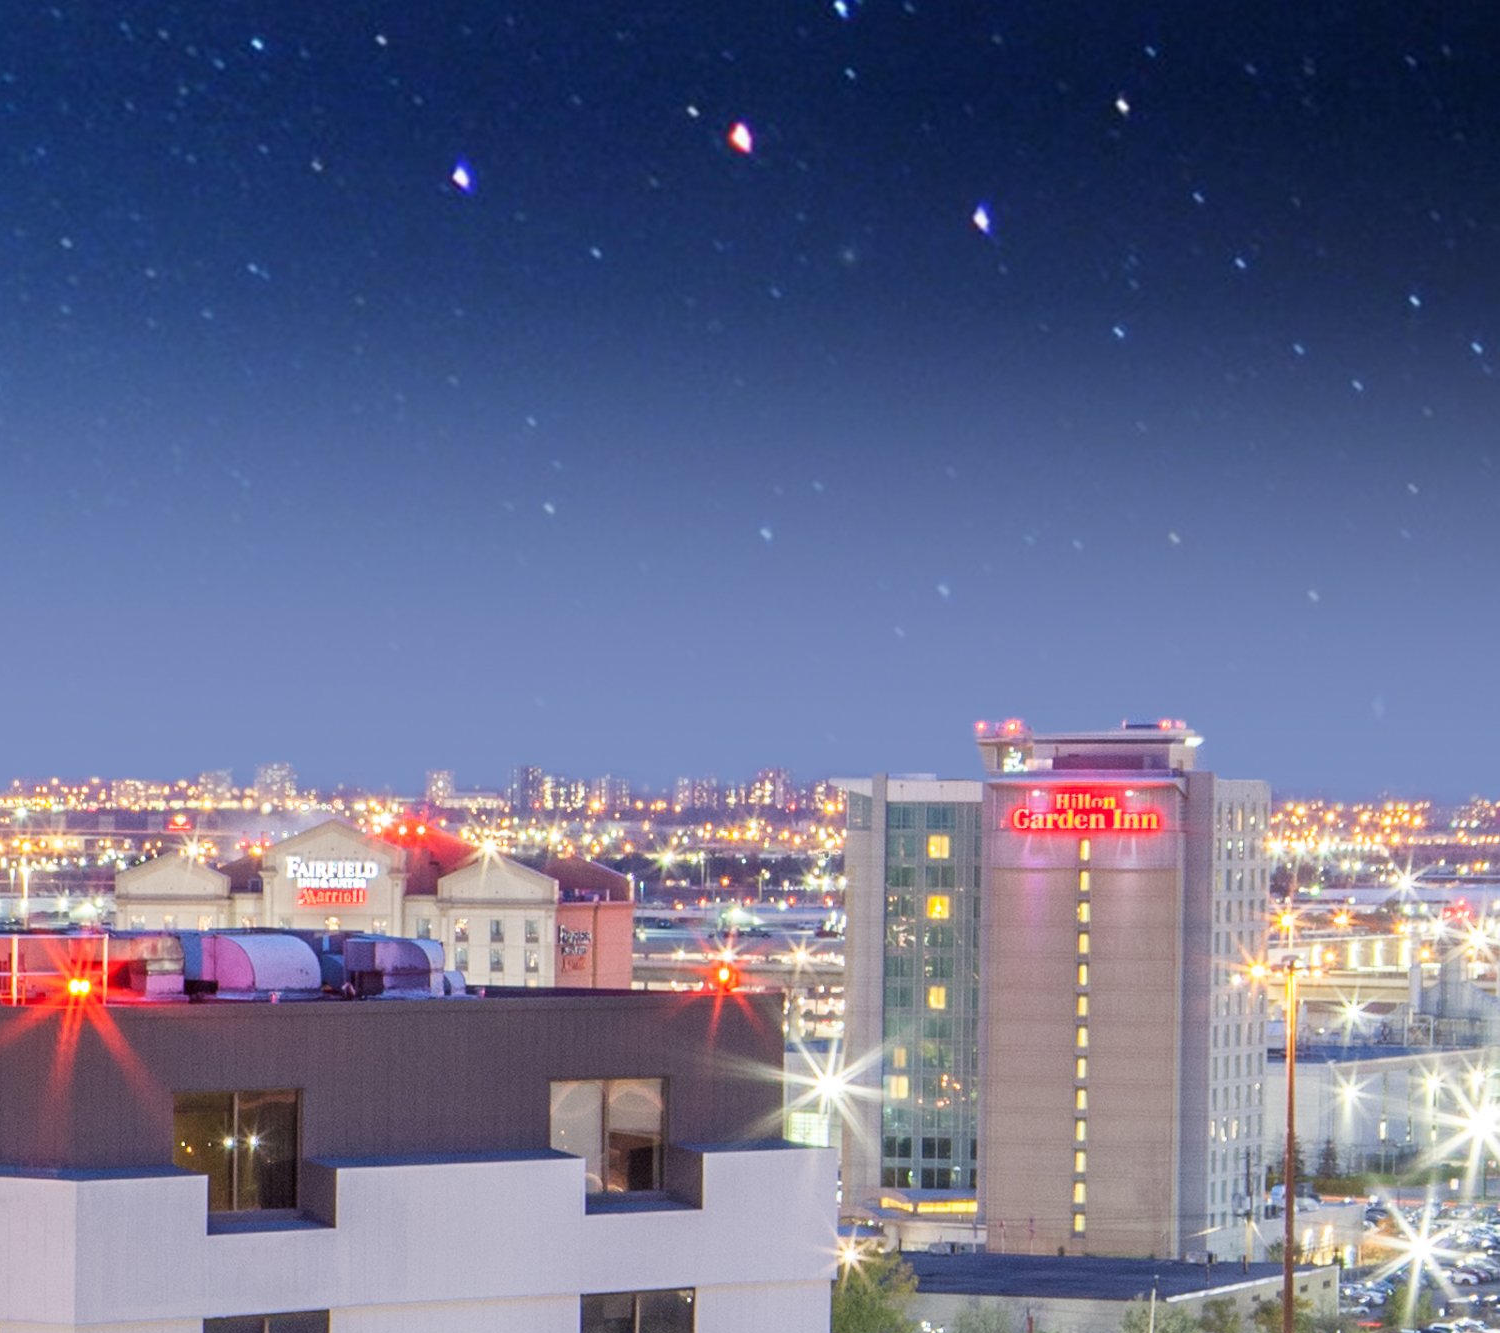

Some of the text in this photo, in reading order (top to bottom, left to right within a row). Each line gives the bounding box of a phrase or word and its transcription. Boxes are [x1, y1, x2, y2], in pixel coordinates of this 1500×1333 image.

[1055, 793, 1116, 810] Hilton
[1012, 809, 1159, 830] Garden Inn
[285, 856, 379, 878] FAIRFIELD
